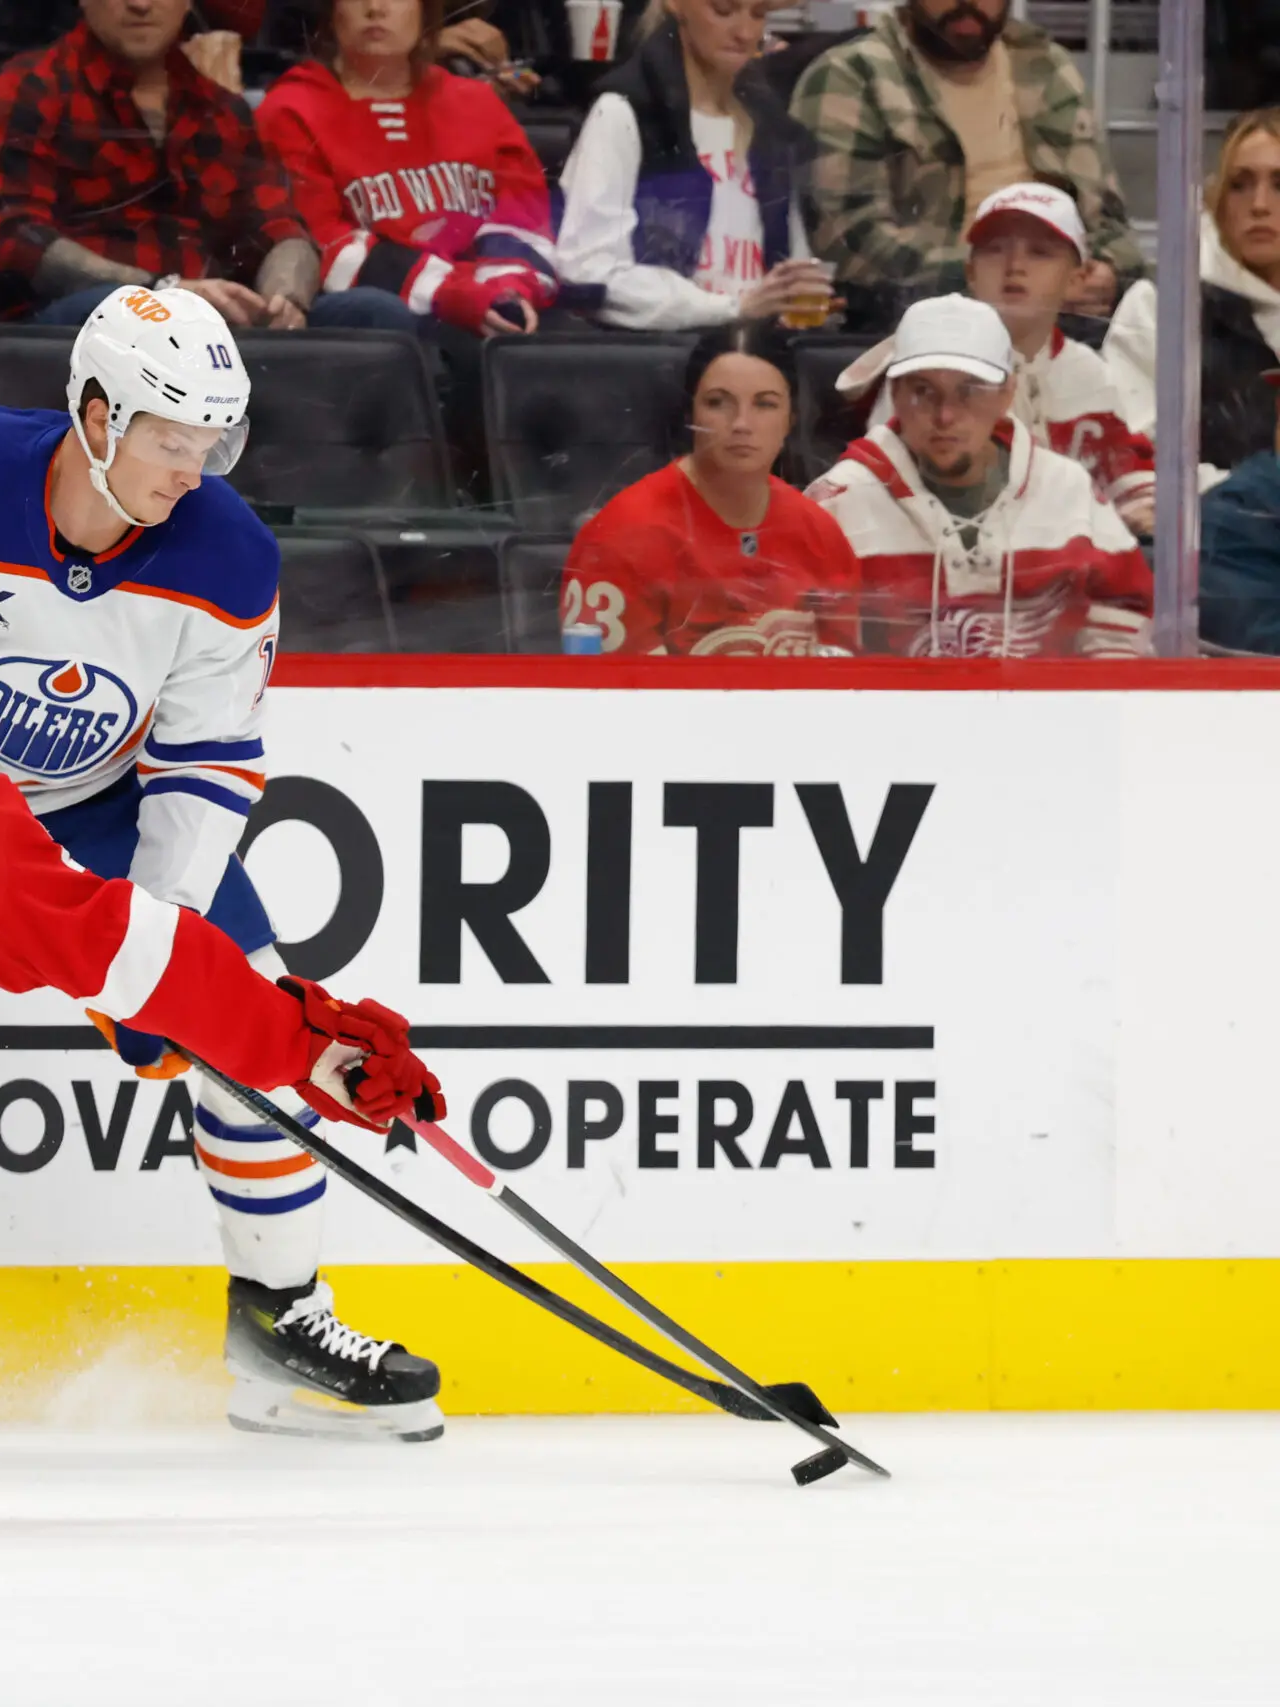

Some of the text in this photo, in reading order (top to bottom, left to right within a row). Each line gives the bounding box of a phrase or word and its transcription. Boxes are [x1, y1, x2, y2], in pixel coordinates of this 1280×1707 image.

[343, 160, 496, 228] RED WINGS
[206, 343, 232, 369] 10
[204, 394, 240, 404] BAUER
[564, 577, 627, 653] 23
[250, 633, 277, 712] 1
[238, 775, 937, 985] ORITY
[470, 1078, 936, 1170] OPERATE
